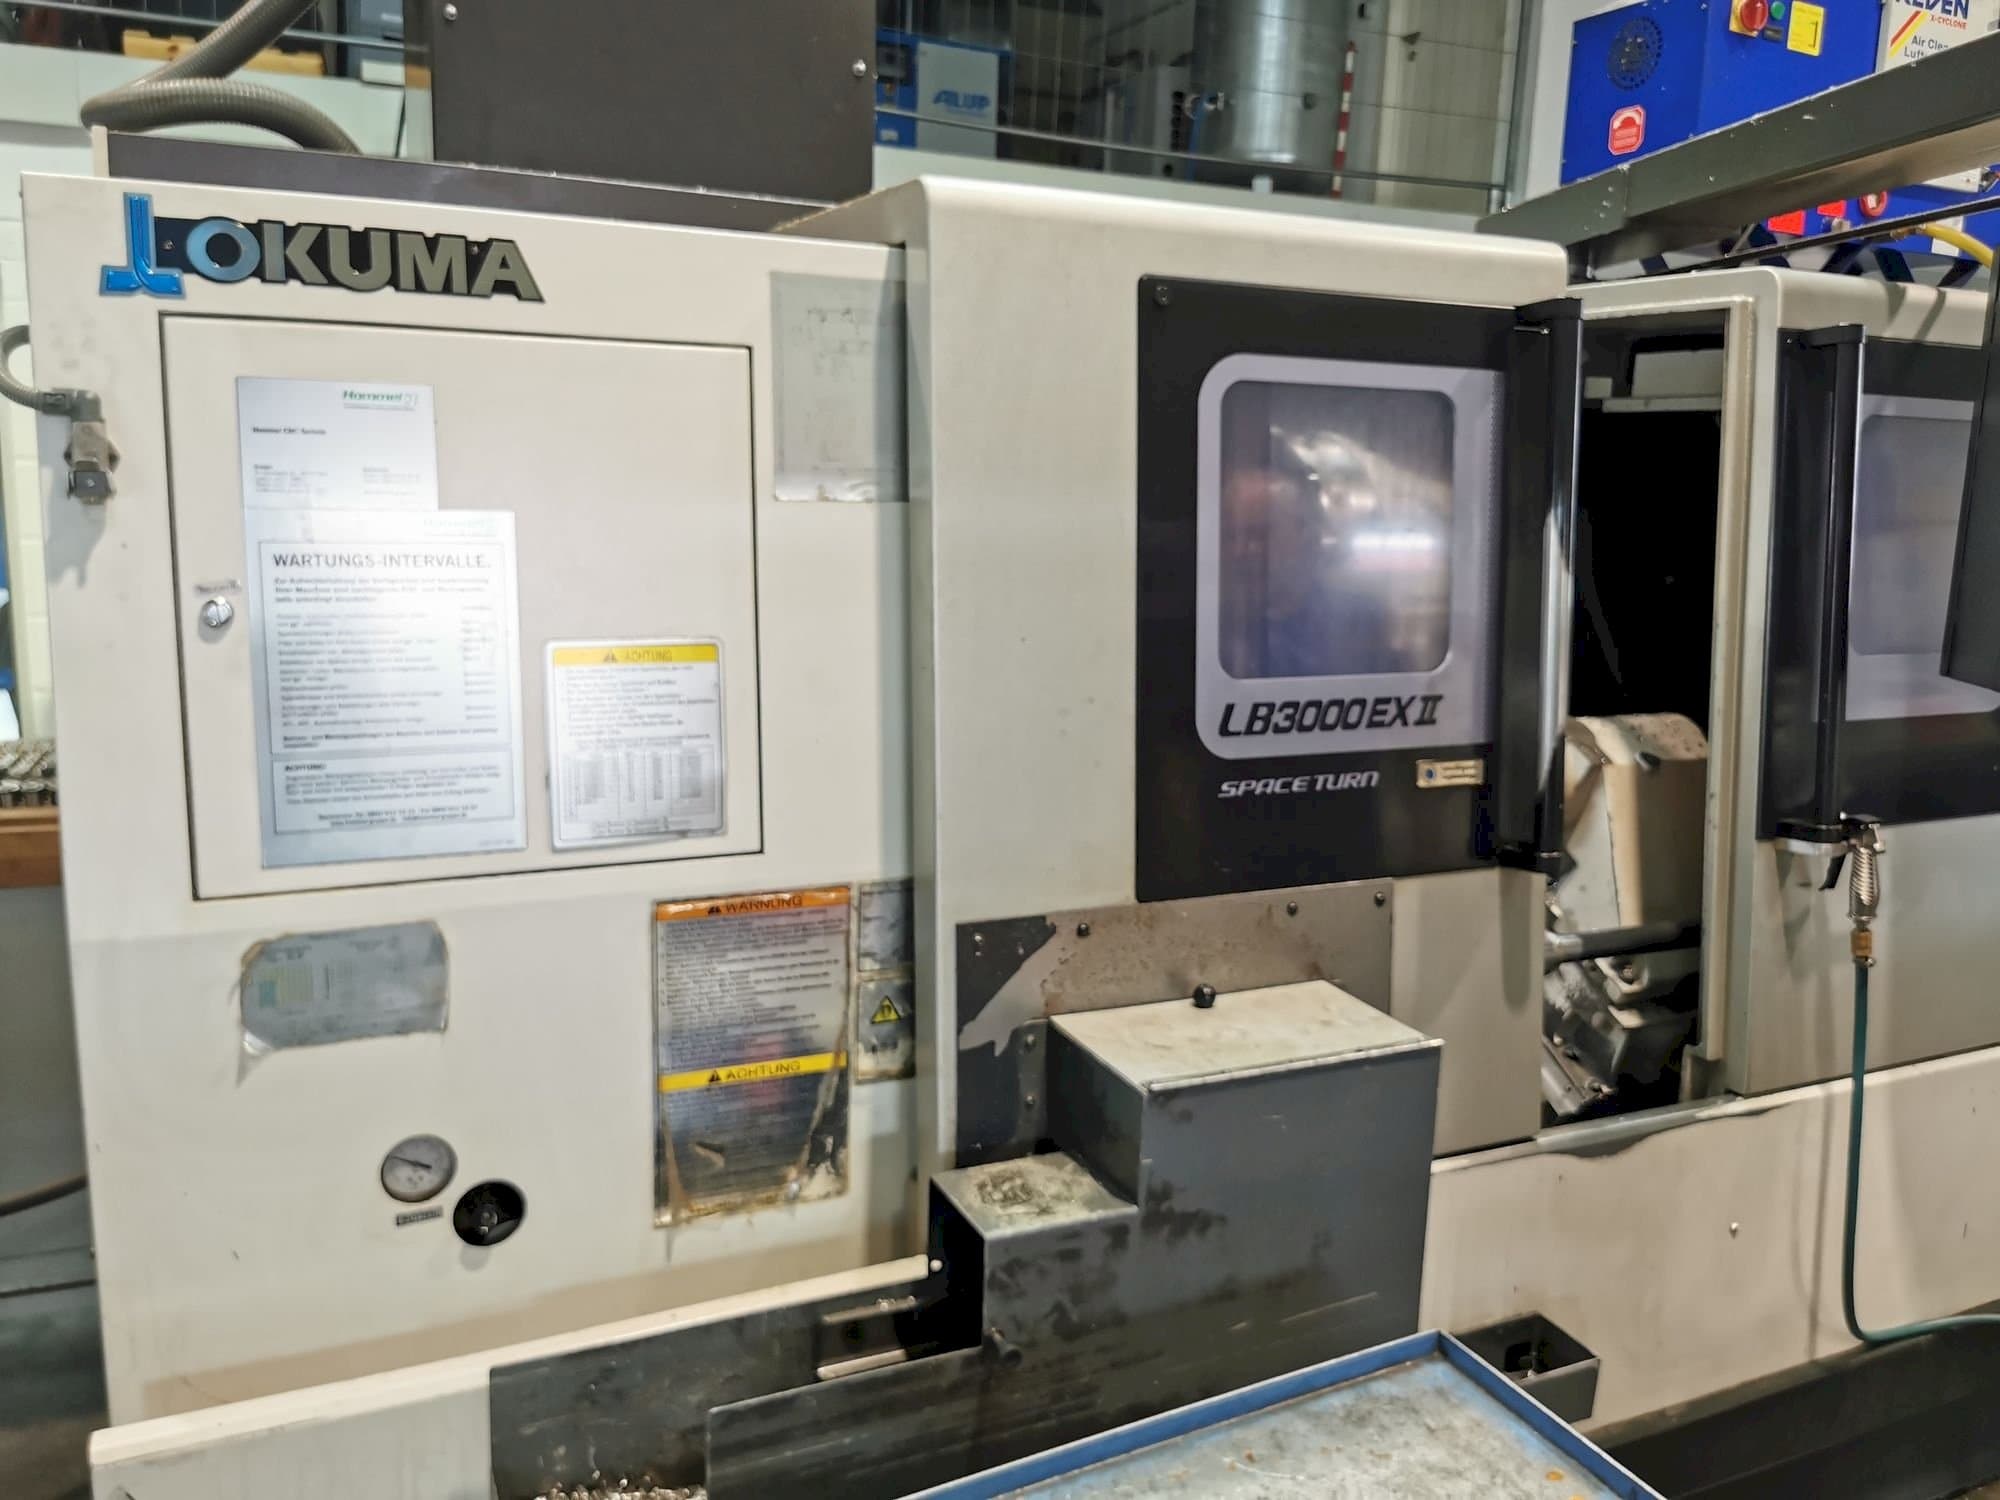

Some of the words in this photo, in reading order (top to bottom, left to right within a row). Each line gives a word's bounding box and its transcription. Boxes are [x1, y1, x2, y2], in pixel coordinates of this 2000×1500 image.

[1911, 35, 1926, 47] Air
[186, 217, 545, 302] OKUMA
[624, 649, 672, 662] ACHTUNG
[1218, 776, 1310, 798] SPACE
[1315, 771, 1379, 791] TURN
[726, 896, 802, 912] WARNUNG
[727, 1060, 801, 1080] ACHTUNG
